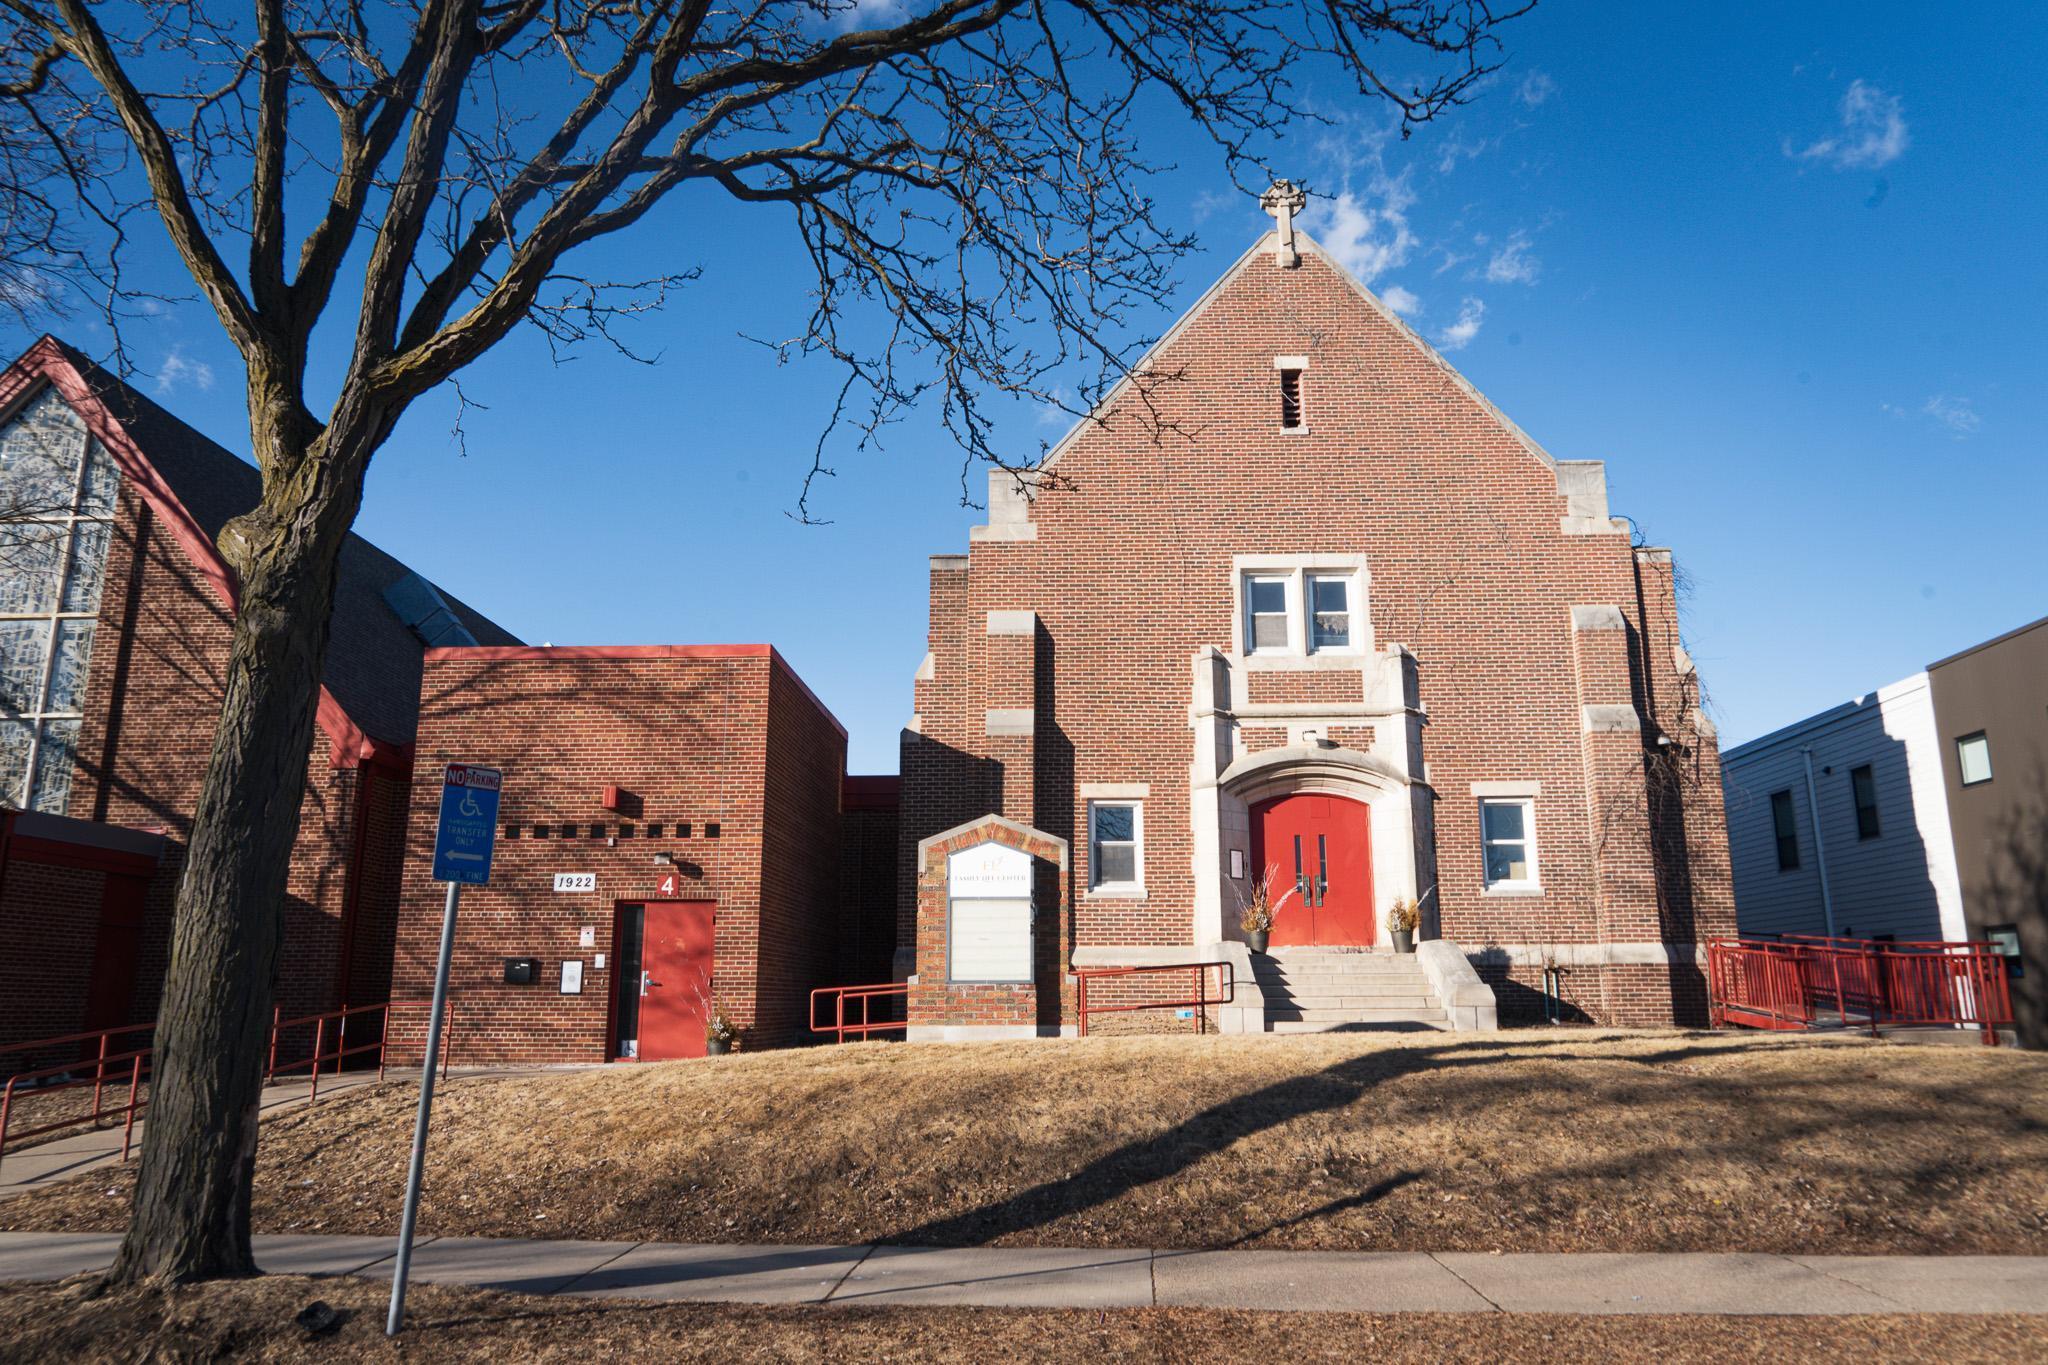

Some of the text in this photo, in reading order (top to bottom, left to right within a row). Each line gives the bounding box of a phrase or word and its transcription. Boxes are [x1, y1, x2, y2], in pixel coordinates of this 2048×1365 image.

[447, 769, 499, 788] NO PARKING
[447, 825, 487, 838] TRANSFER
[455, 836, 475, 847] ONLY
[559, 877, 592, 888] 1922
[661, 876, 674, 896] 4
